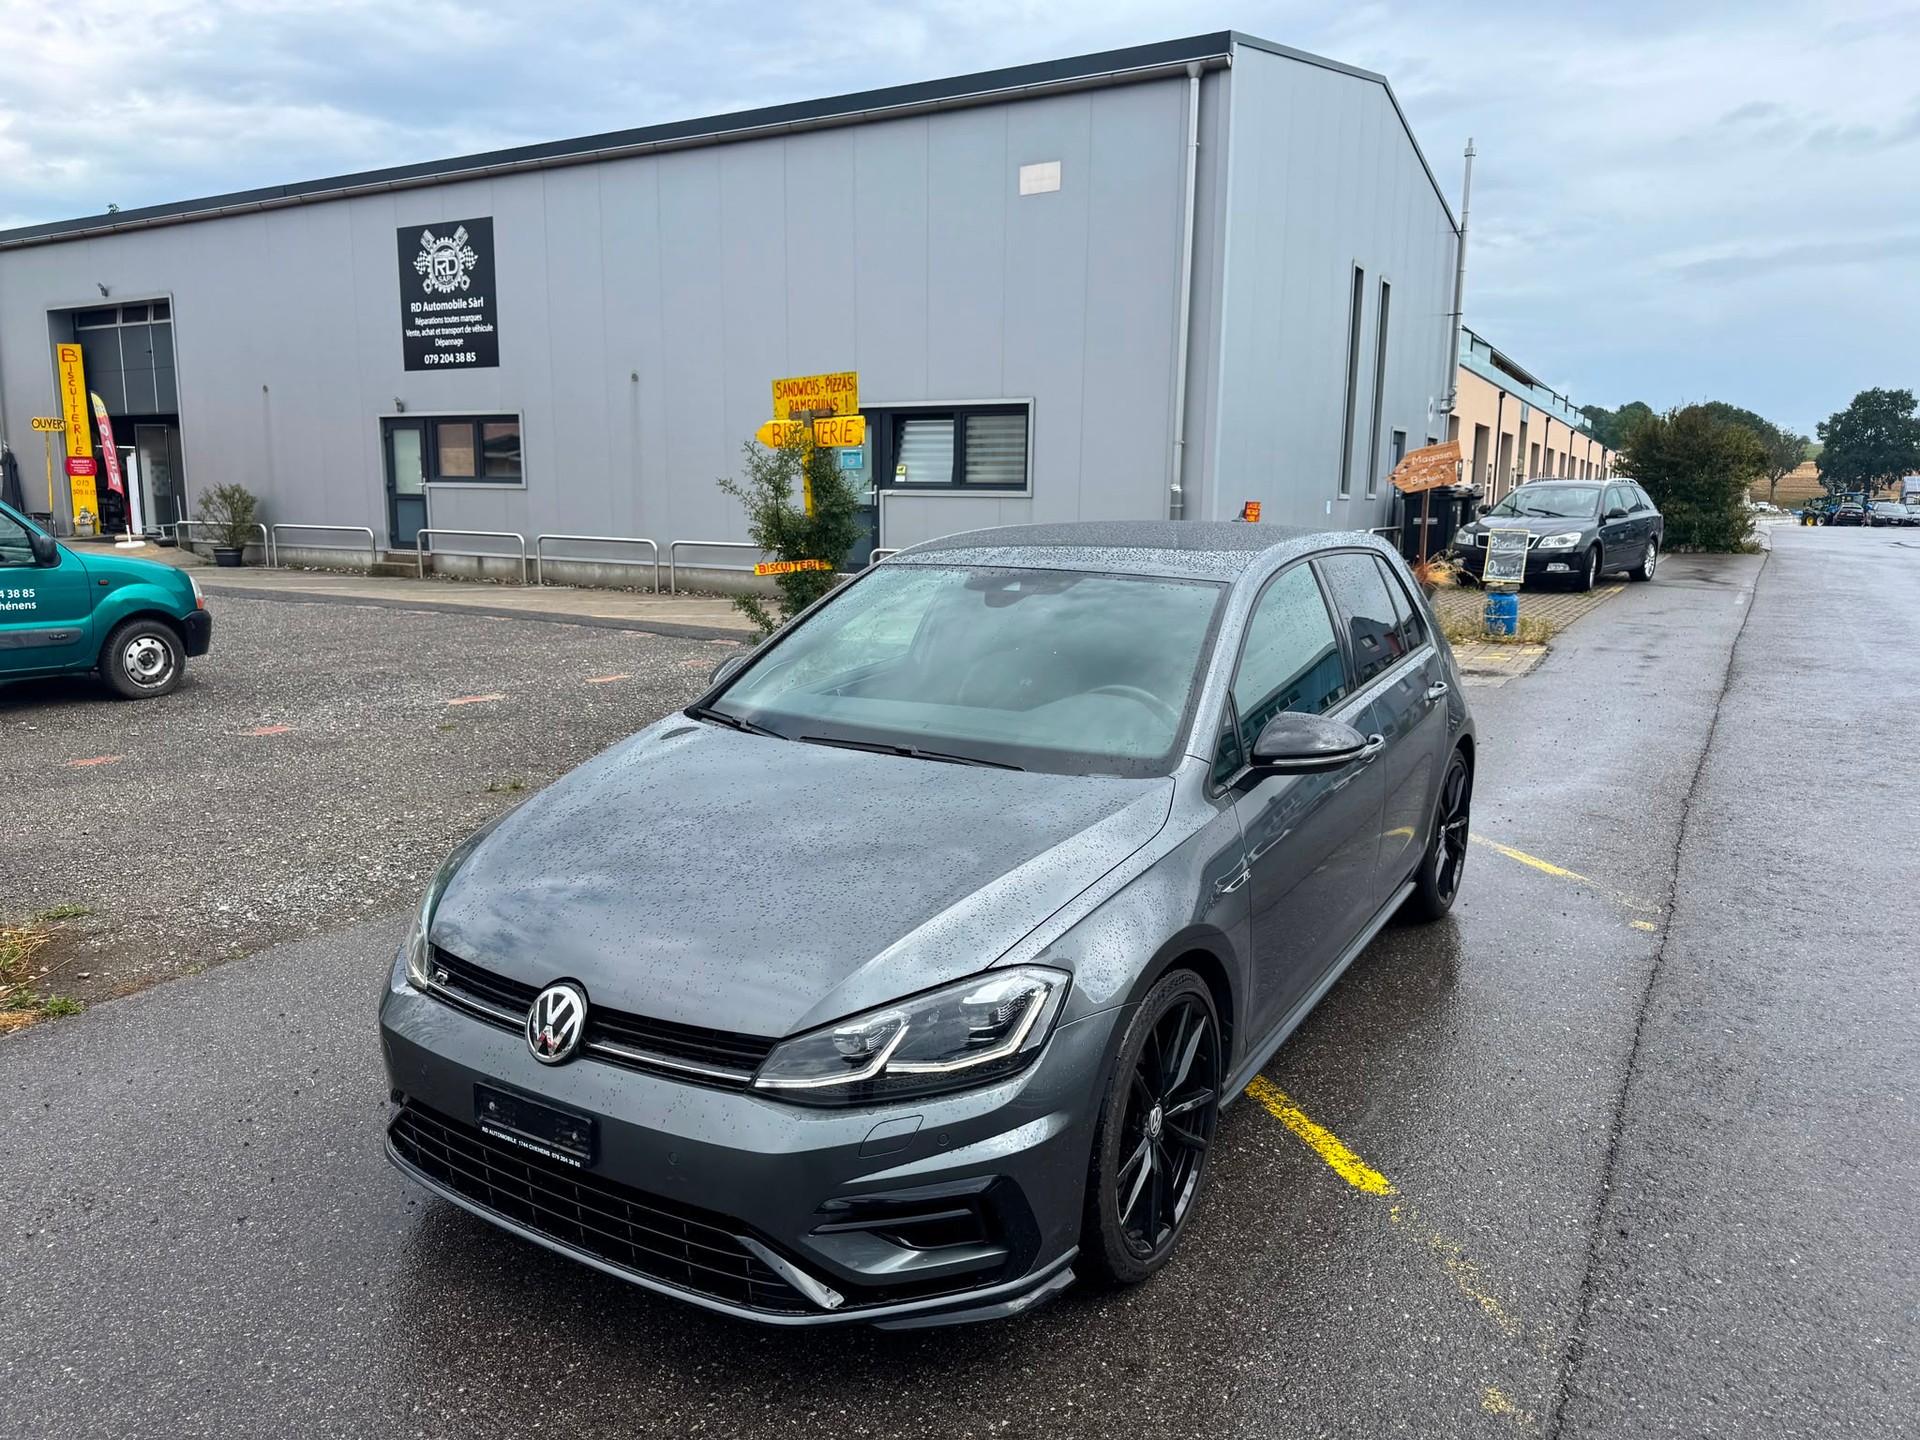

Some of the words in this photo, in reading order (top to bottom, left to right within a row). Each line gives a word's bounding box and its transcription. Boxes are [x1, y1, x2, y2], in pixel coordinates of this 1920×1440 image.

[434, 256, 458, 276] RD
[411, 302, 421, 312] RD
[423, 298, 467, 312] Automobile
[468, 296, 484, 308] Sàrl
[415, 316, 443, 326] Réparations
[444, 315, 460, 324] toutes
[460, 314, 483, 323] marques
[405, 329, 421, 337] Vente,
[421, 327, 435, 336] achat
[441, 325, 464, 335] transport
[464, 325, 471, 333] de
[472, 323, 494, 333] véhicule
[435, 338, 464, 347] Dépannage
[424, 354, 439, 364] 079
[440, 353, 454, 364] 204
[455, 352, 465, 363] 38
[466, 352, 476, 362] 85
[31, 418, 67, 430] OUVERT
[1412, 452, 1453, 467] Magasin
[1488, 560, 1521, 575] Ouvert
[7, 589, 20, 599] 38
[22, 588, 35, 598] 85
[481, 1126, 489, 1134] RD
[489, 1129, 517, 1145] AUTOMOBILE
